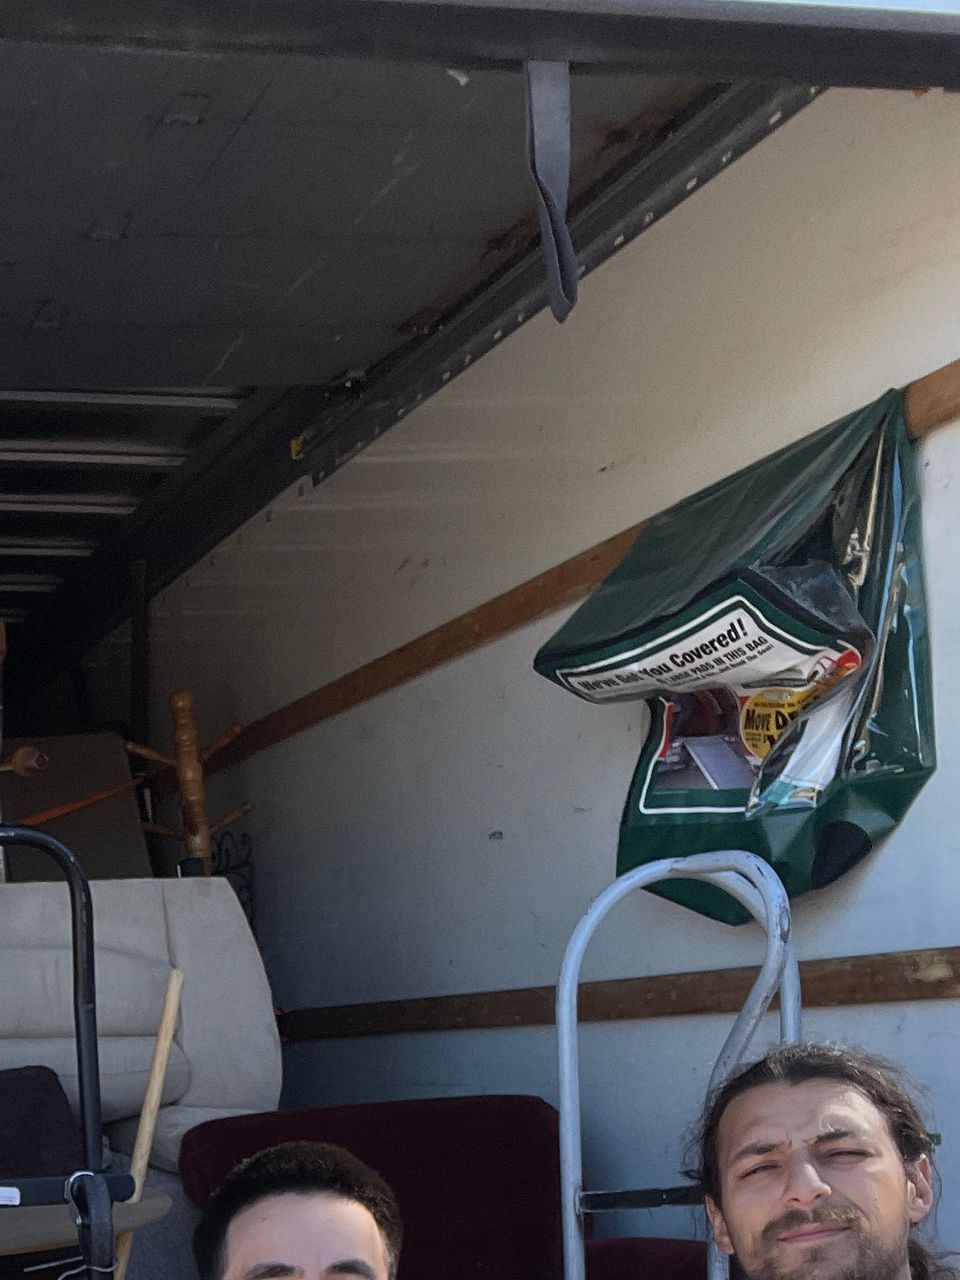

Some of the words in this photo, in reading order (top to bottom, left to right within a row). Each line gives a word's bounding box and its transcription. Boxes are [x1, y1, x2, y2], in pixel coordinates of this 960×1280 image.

[577, 674, 620, 691] We've
[639, 662, 673, 679] You
[669, 617, 748, 668] Covered!
[689, 662, 715, 676] PADS
[713, 656, 726, 666] IN
[724, 647, 747, 662] THIS
[745, 636, 768, 652] BAG
